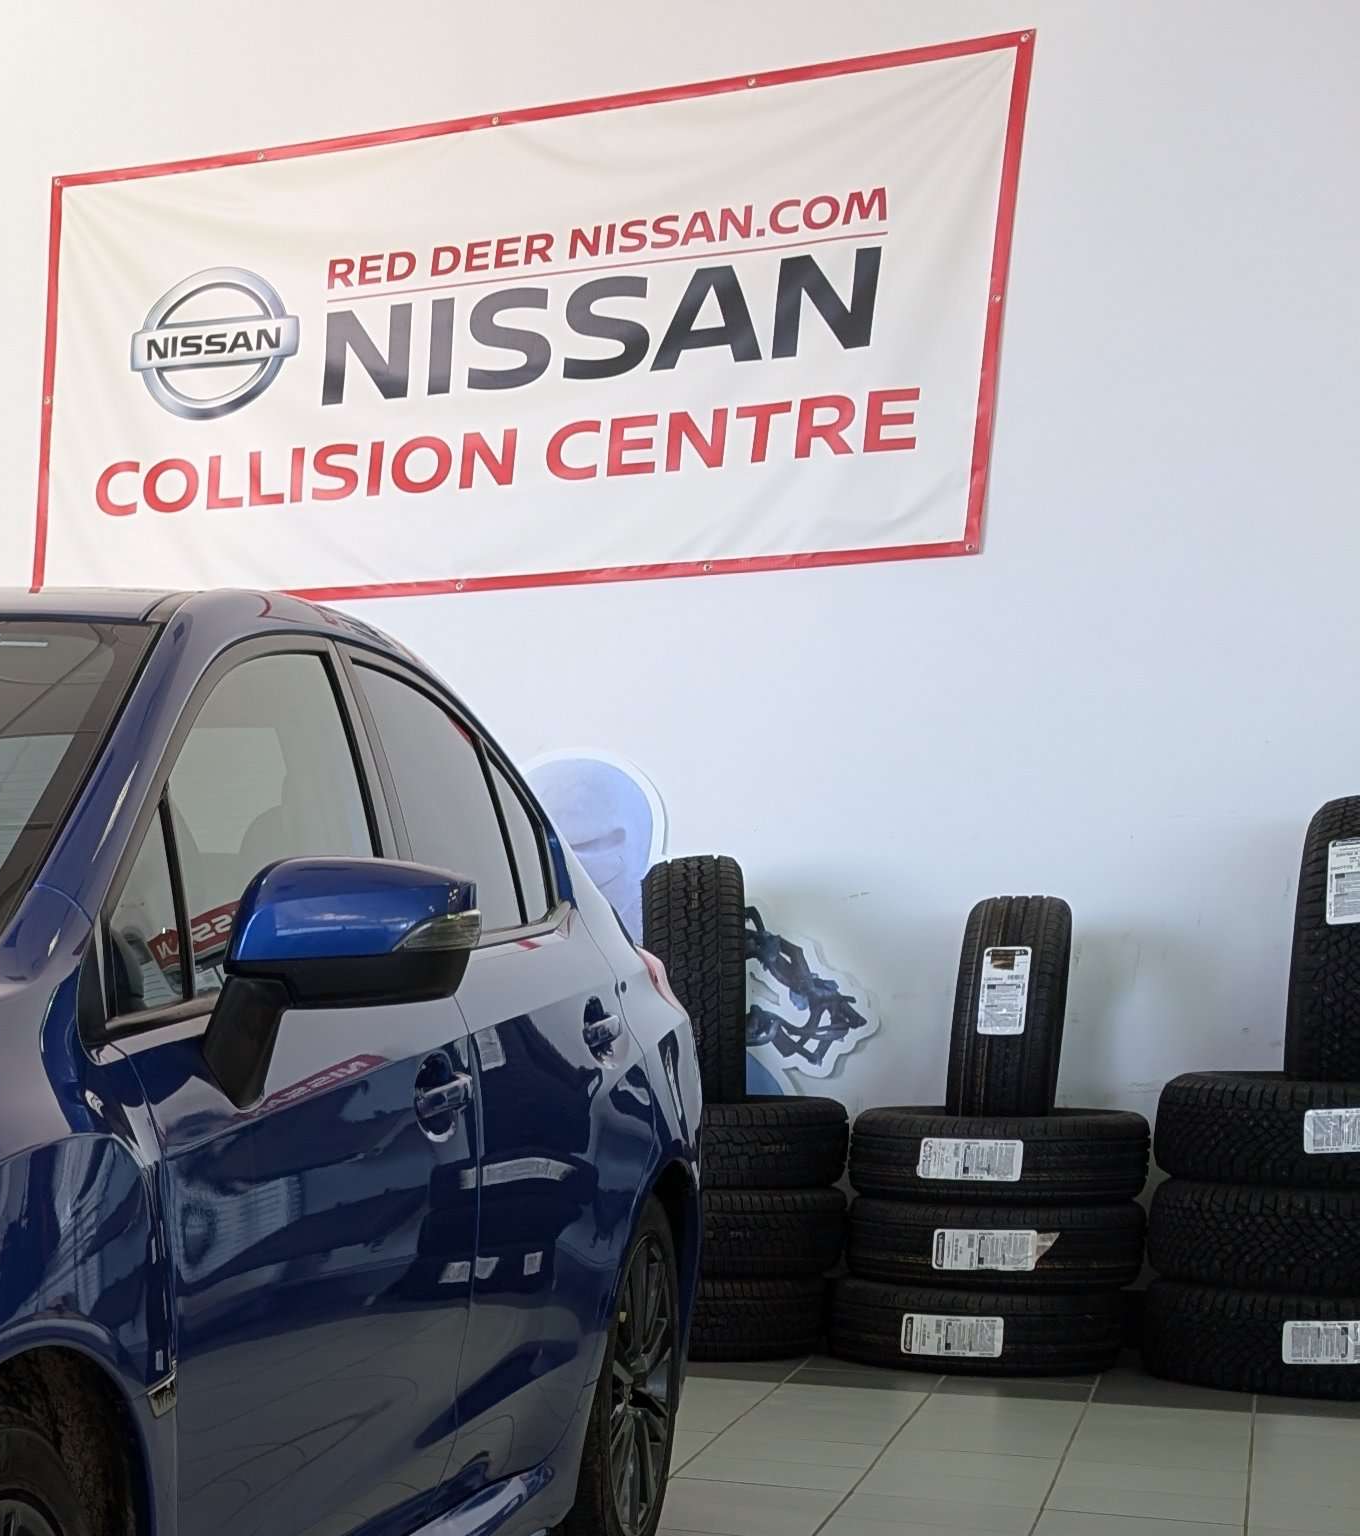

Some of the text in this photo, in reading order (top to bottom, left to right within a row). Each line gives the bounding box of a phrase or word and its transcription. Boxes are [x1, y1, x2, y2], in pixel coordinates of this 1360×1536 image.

[328, 187, 889, 290] RED DEER NISSAN.COM
[146, 326, 282, 362] NISSAN
[321, 246, 883, 406] NISSAN
[95, 388, 921, 517] COLLISION CENTRE
